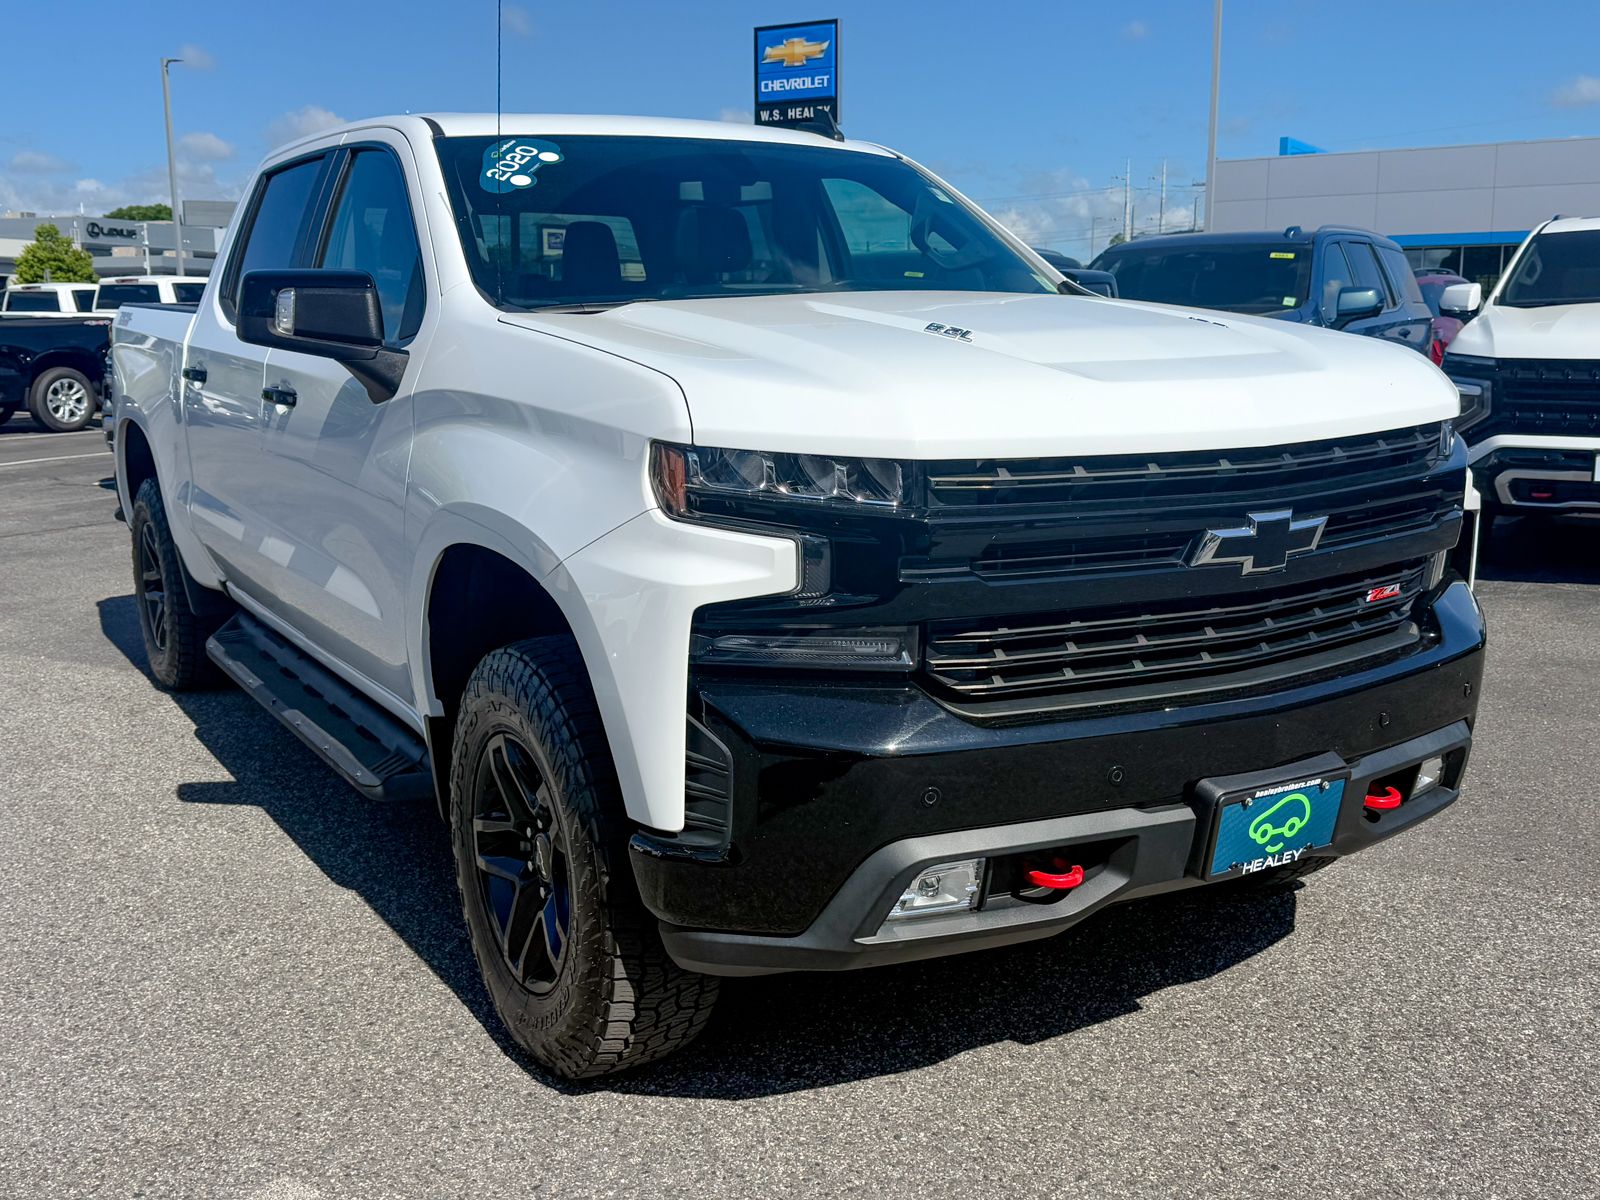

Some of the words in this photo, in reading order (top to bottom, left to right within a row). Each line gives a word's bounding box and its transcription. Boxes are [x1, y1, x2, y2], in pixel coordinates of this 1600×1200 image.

[761, 75, 830, 93] CHEVROLET
[760, 109, 783, 121] W.S.
[787, 105, 831, 120] HEALY
[486, 146, 539, 181] 2020
[1255, 778, 1322, 798] healeybrothers.com
[1242, 848, 1303, 875] HEALEY
